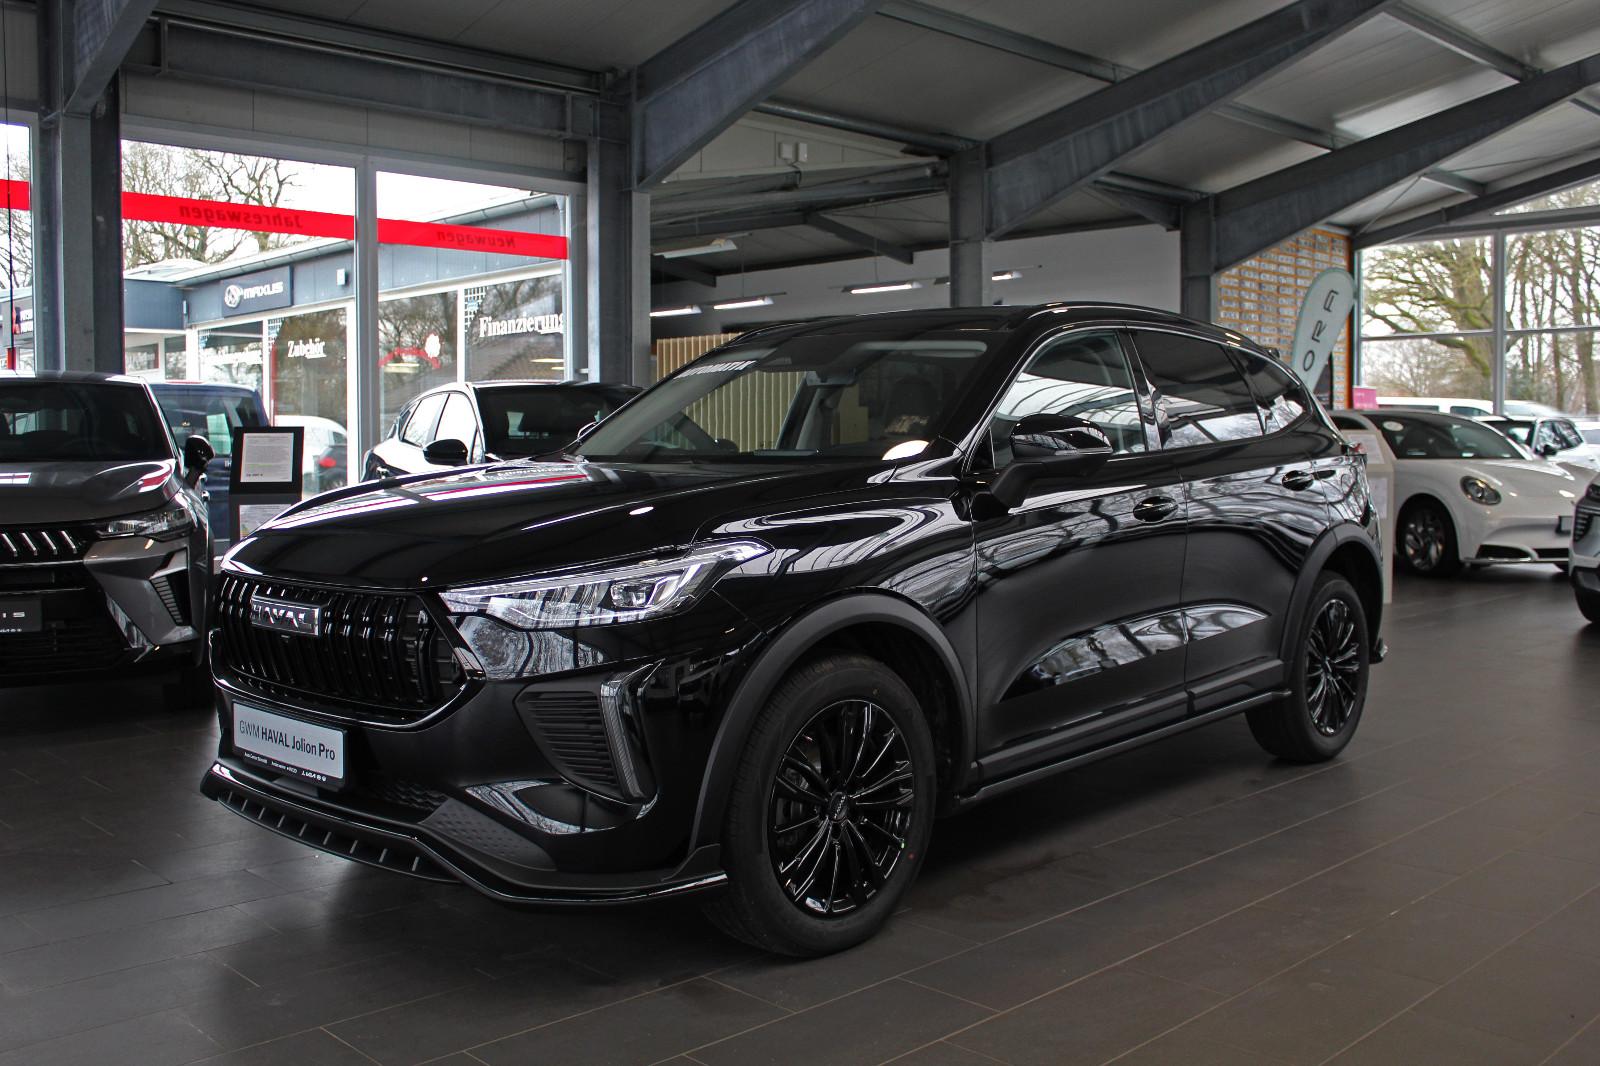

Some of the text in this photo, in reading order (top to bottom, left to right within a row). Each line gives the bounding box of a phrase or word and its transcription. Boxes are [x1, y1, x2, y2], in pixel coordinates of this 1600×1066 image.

[243, 281, 284, 300] MAXUS
[1302, 289, 1339, 372] ORA
[287, 337, 326, 359] Zubehör
[249, 603, 313, 630] HAVAL
[239, 719, 336, 761] GWM HAVAL Jolion Pro
